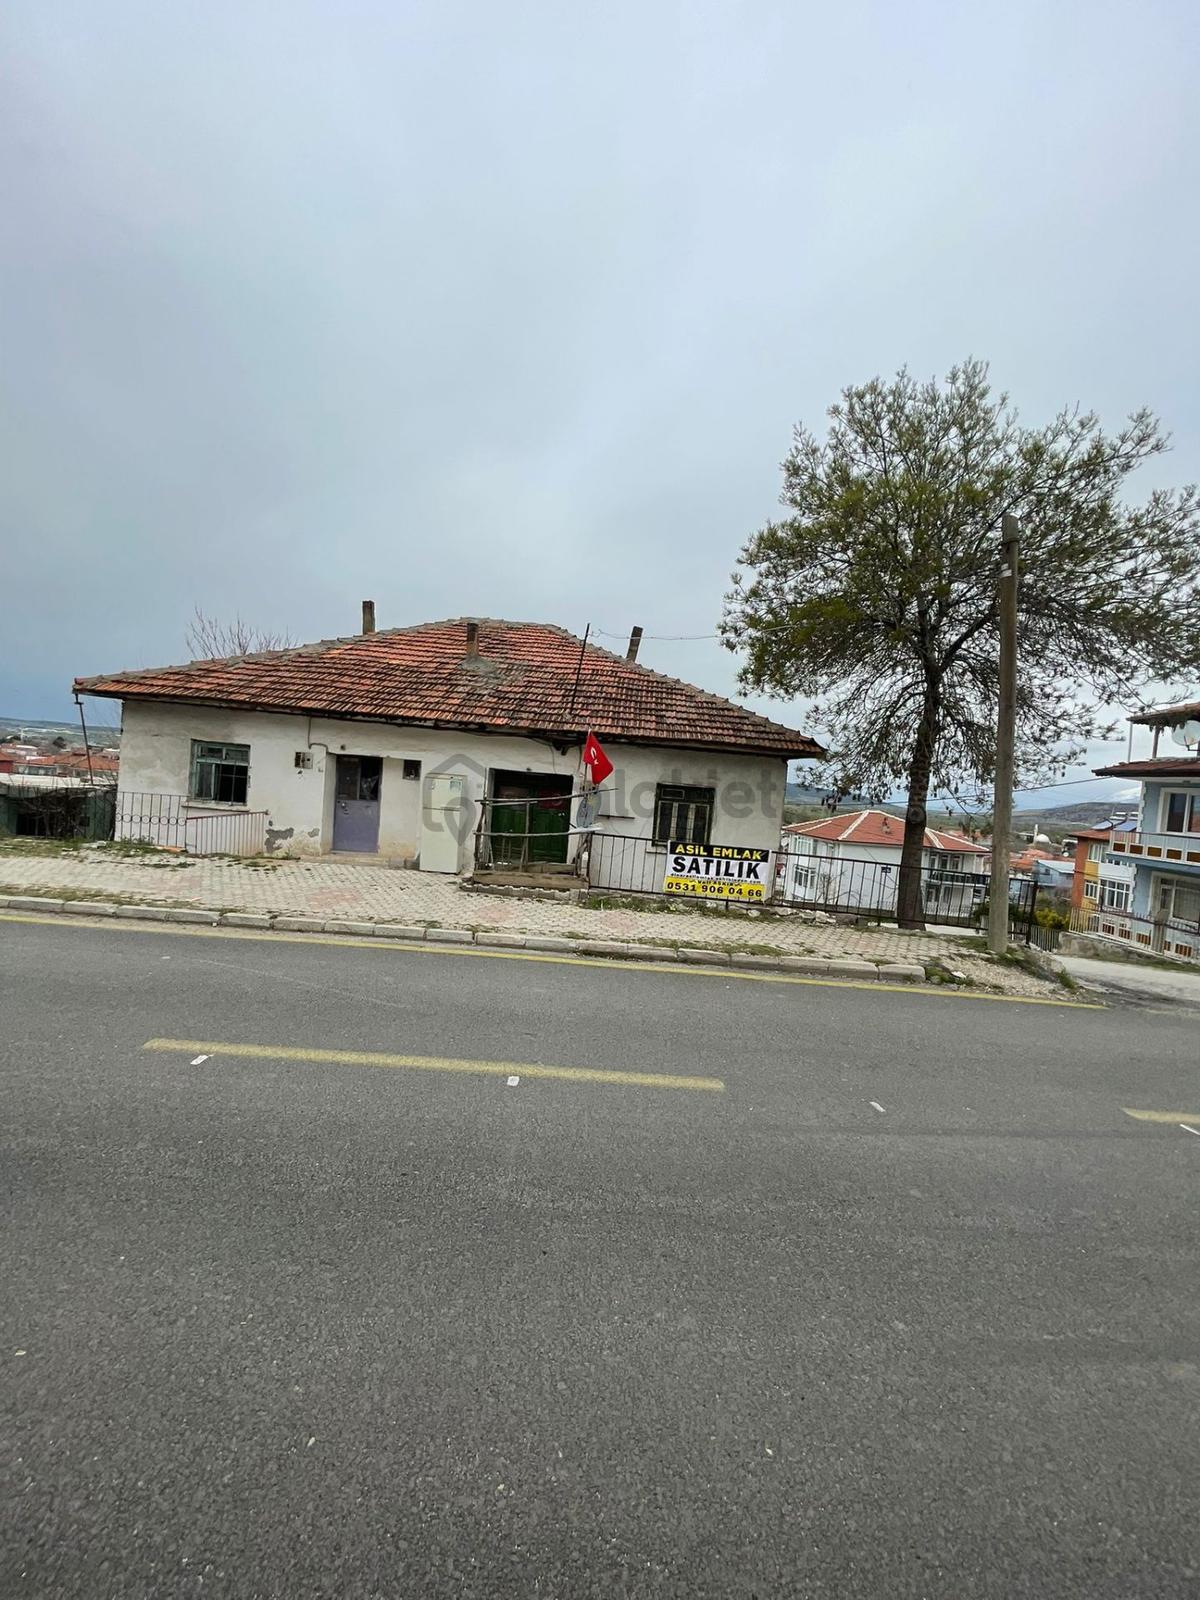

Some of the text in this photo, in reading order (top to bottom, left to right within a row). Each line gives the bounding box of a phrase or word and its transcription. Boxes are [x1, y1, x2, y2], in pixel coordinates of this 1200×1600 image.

[712, 847, 762, 860] EMLAK
[671, 855, 761, 879] SATILIK
[667, 882, 697, 892] 0531
[701, 885, 724, 894] 906
[728, 887, 743, 896] 04
[747, 889, 762, 898] 66
